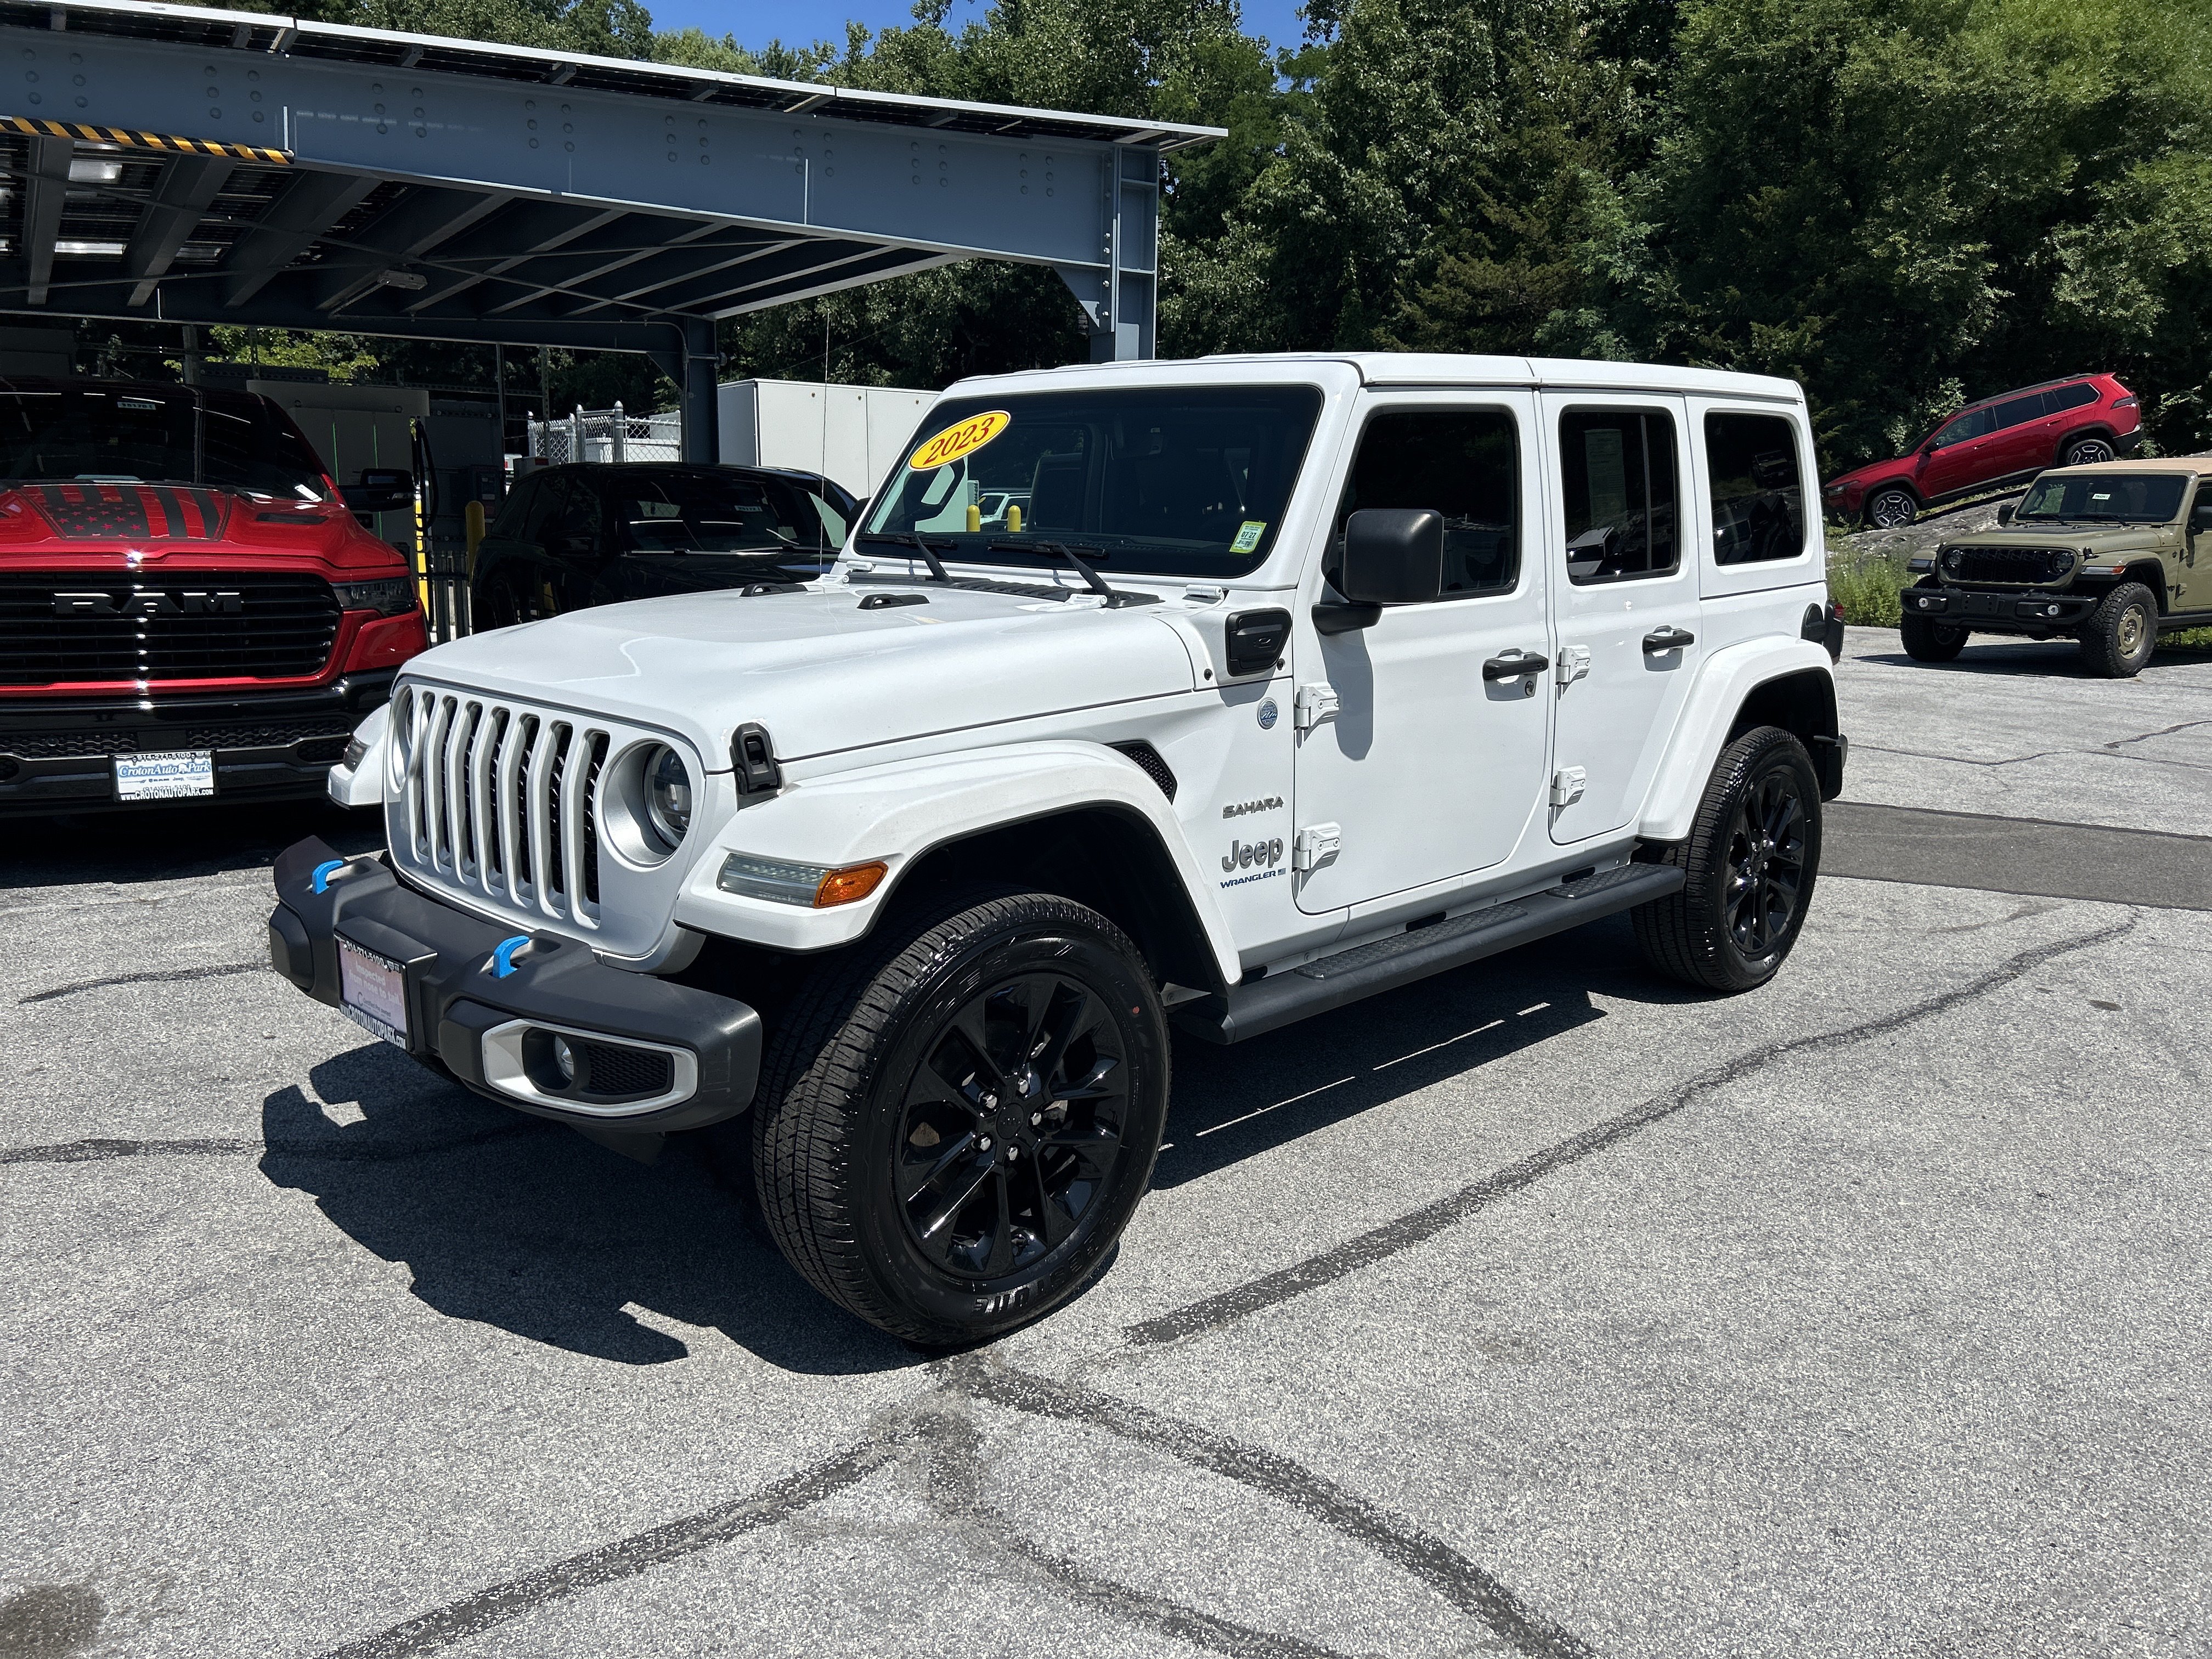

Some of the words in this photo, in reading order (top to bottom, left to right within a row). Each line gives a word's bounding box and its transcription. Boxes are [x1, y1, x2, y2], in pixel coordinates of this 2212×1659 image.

[923, 417, 995, 465] 2023
[54, 593, 241, 613] RAM
[1222, 796, 1284, 819] SAHARA
[1222, 838, 1284, 872] Jeep
[1220, 870, 1276, 889] WRANGLER
[356, 959, 386, 986] Inspected
